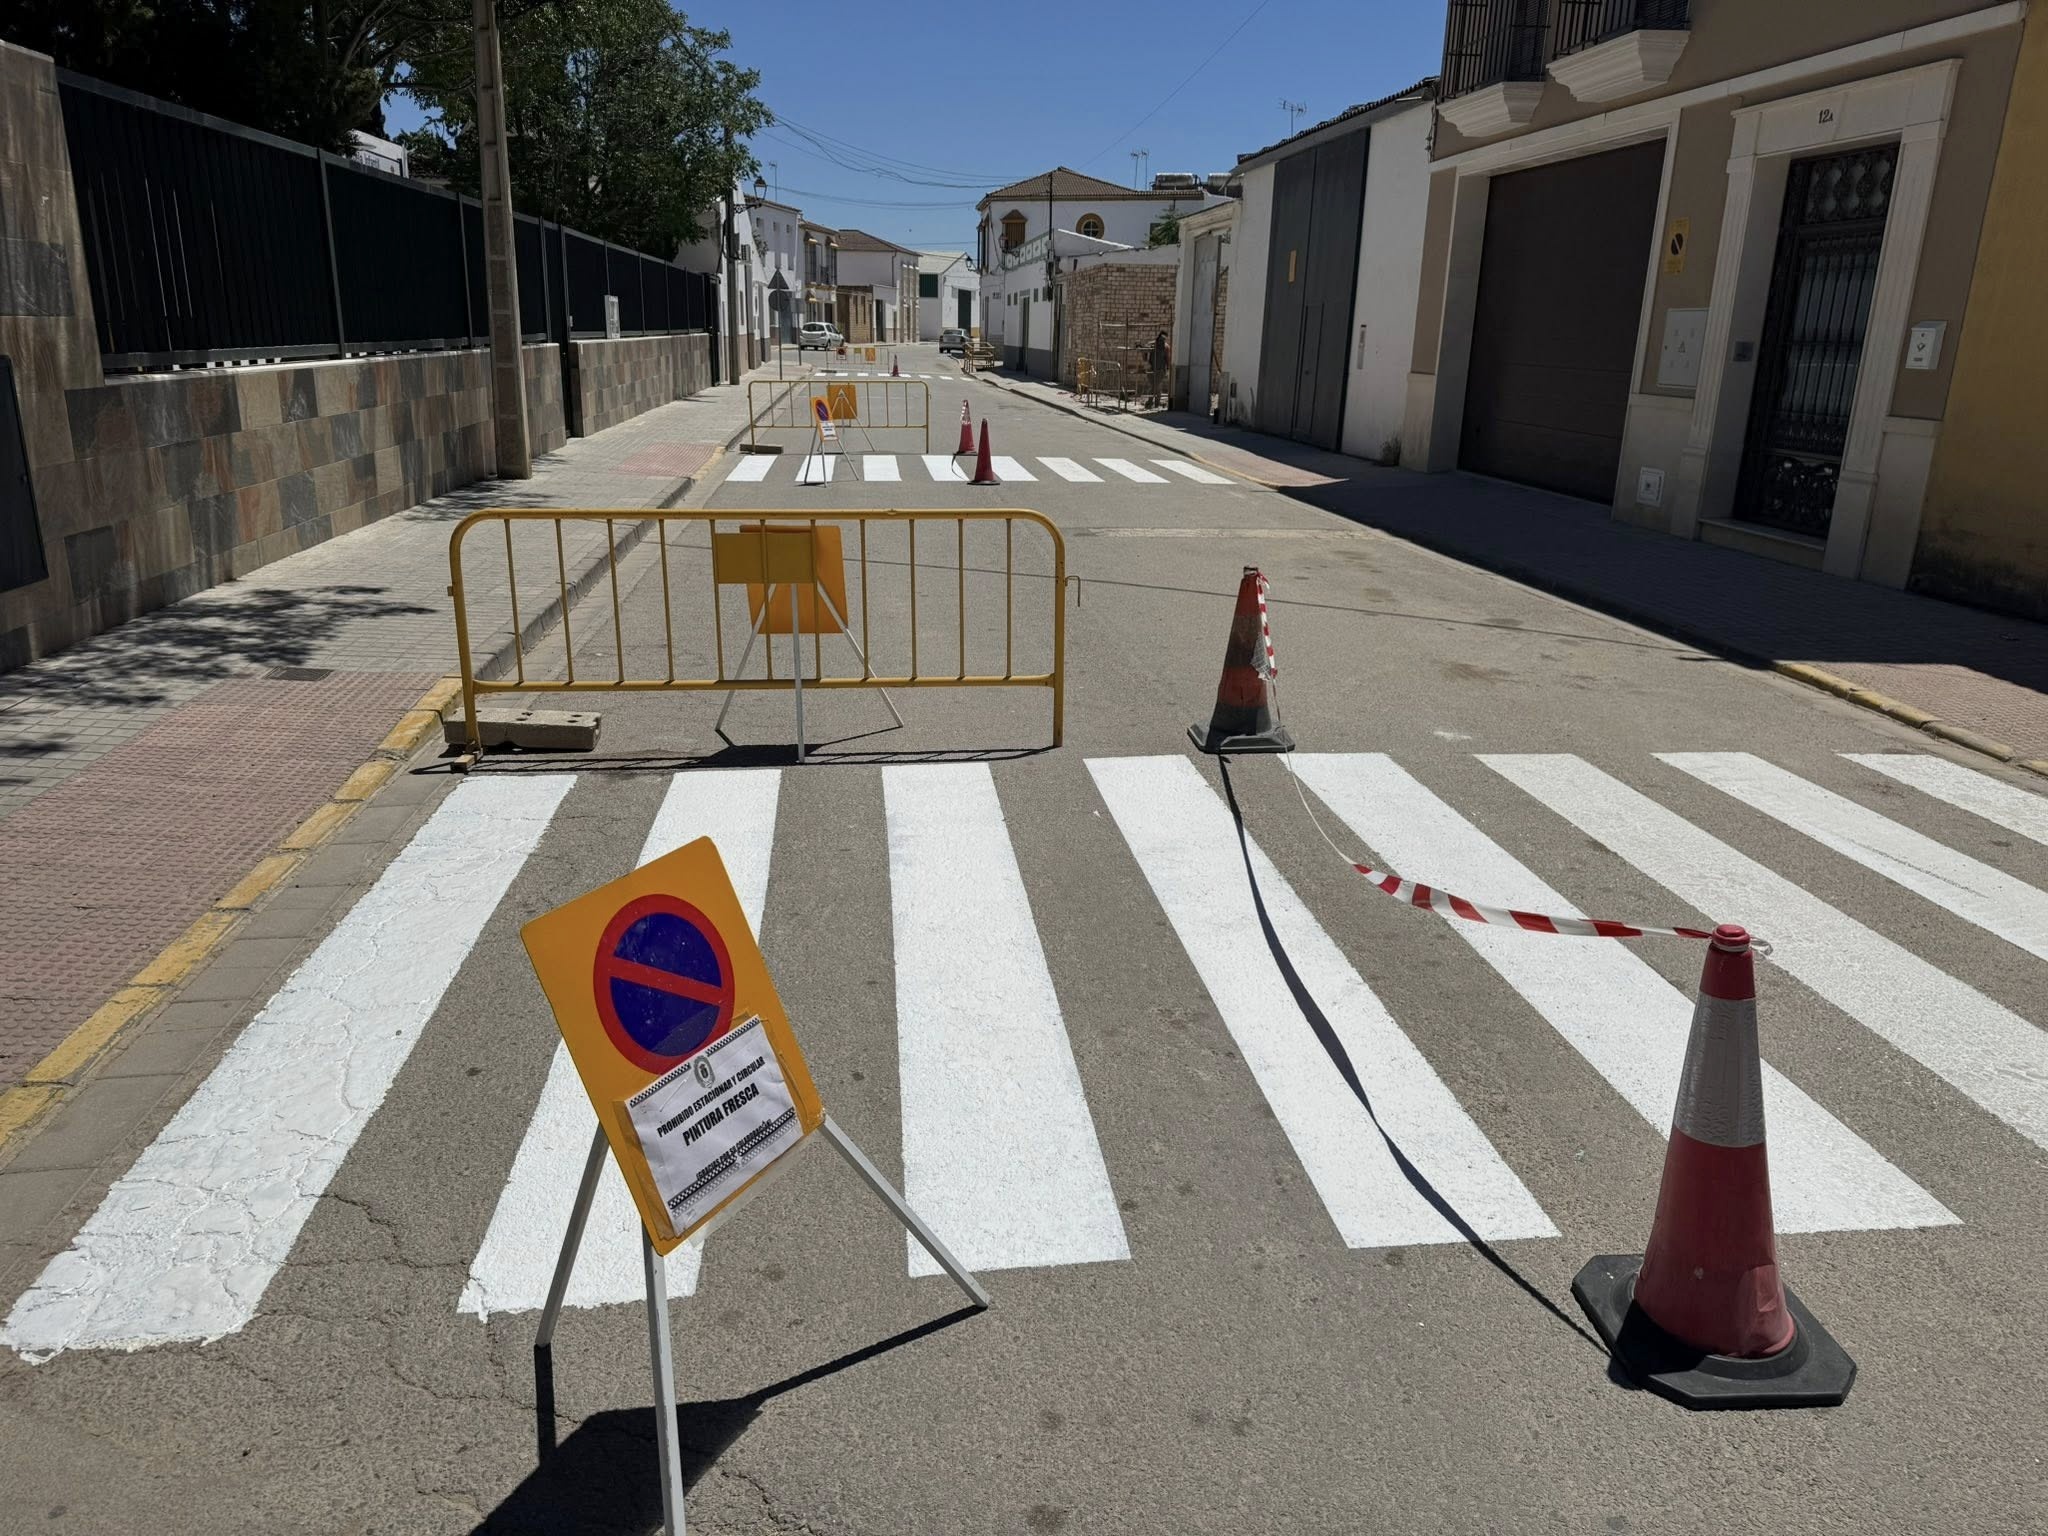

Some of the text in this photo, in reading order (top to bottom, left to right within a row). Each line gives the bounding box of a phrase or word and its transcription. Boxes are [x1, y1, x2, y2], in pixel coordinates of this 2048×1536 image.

[656, 1105, 695, 1138] PROHIBIDO
[693, 1078, 734, 1113] ESTACIONAR
[731, 1076, 737, 1086] Y
[736, 1056, 766, 1082] CIRCULAR
[682, 1082, 760, 1147] PINTURA FRESCA
[719, 1151, 732, 1164] POR
[729, 1145, 738, 1155] SU
